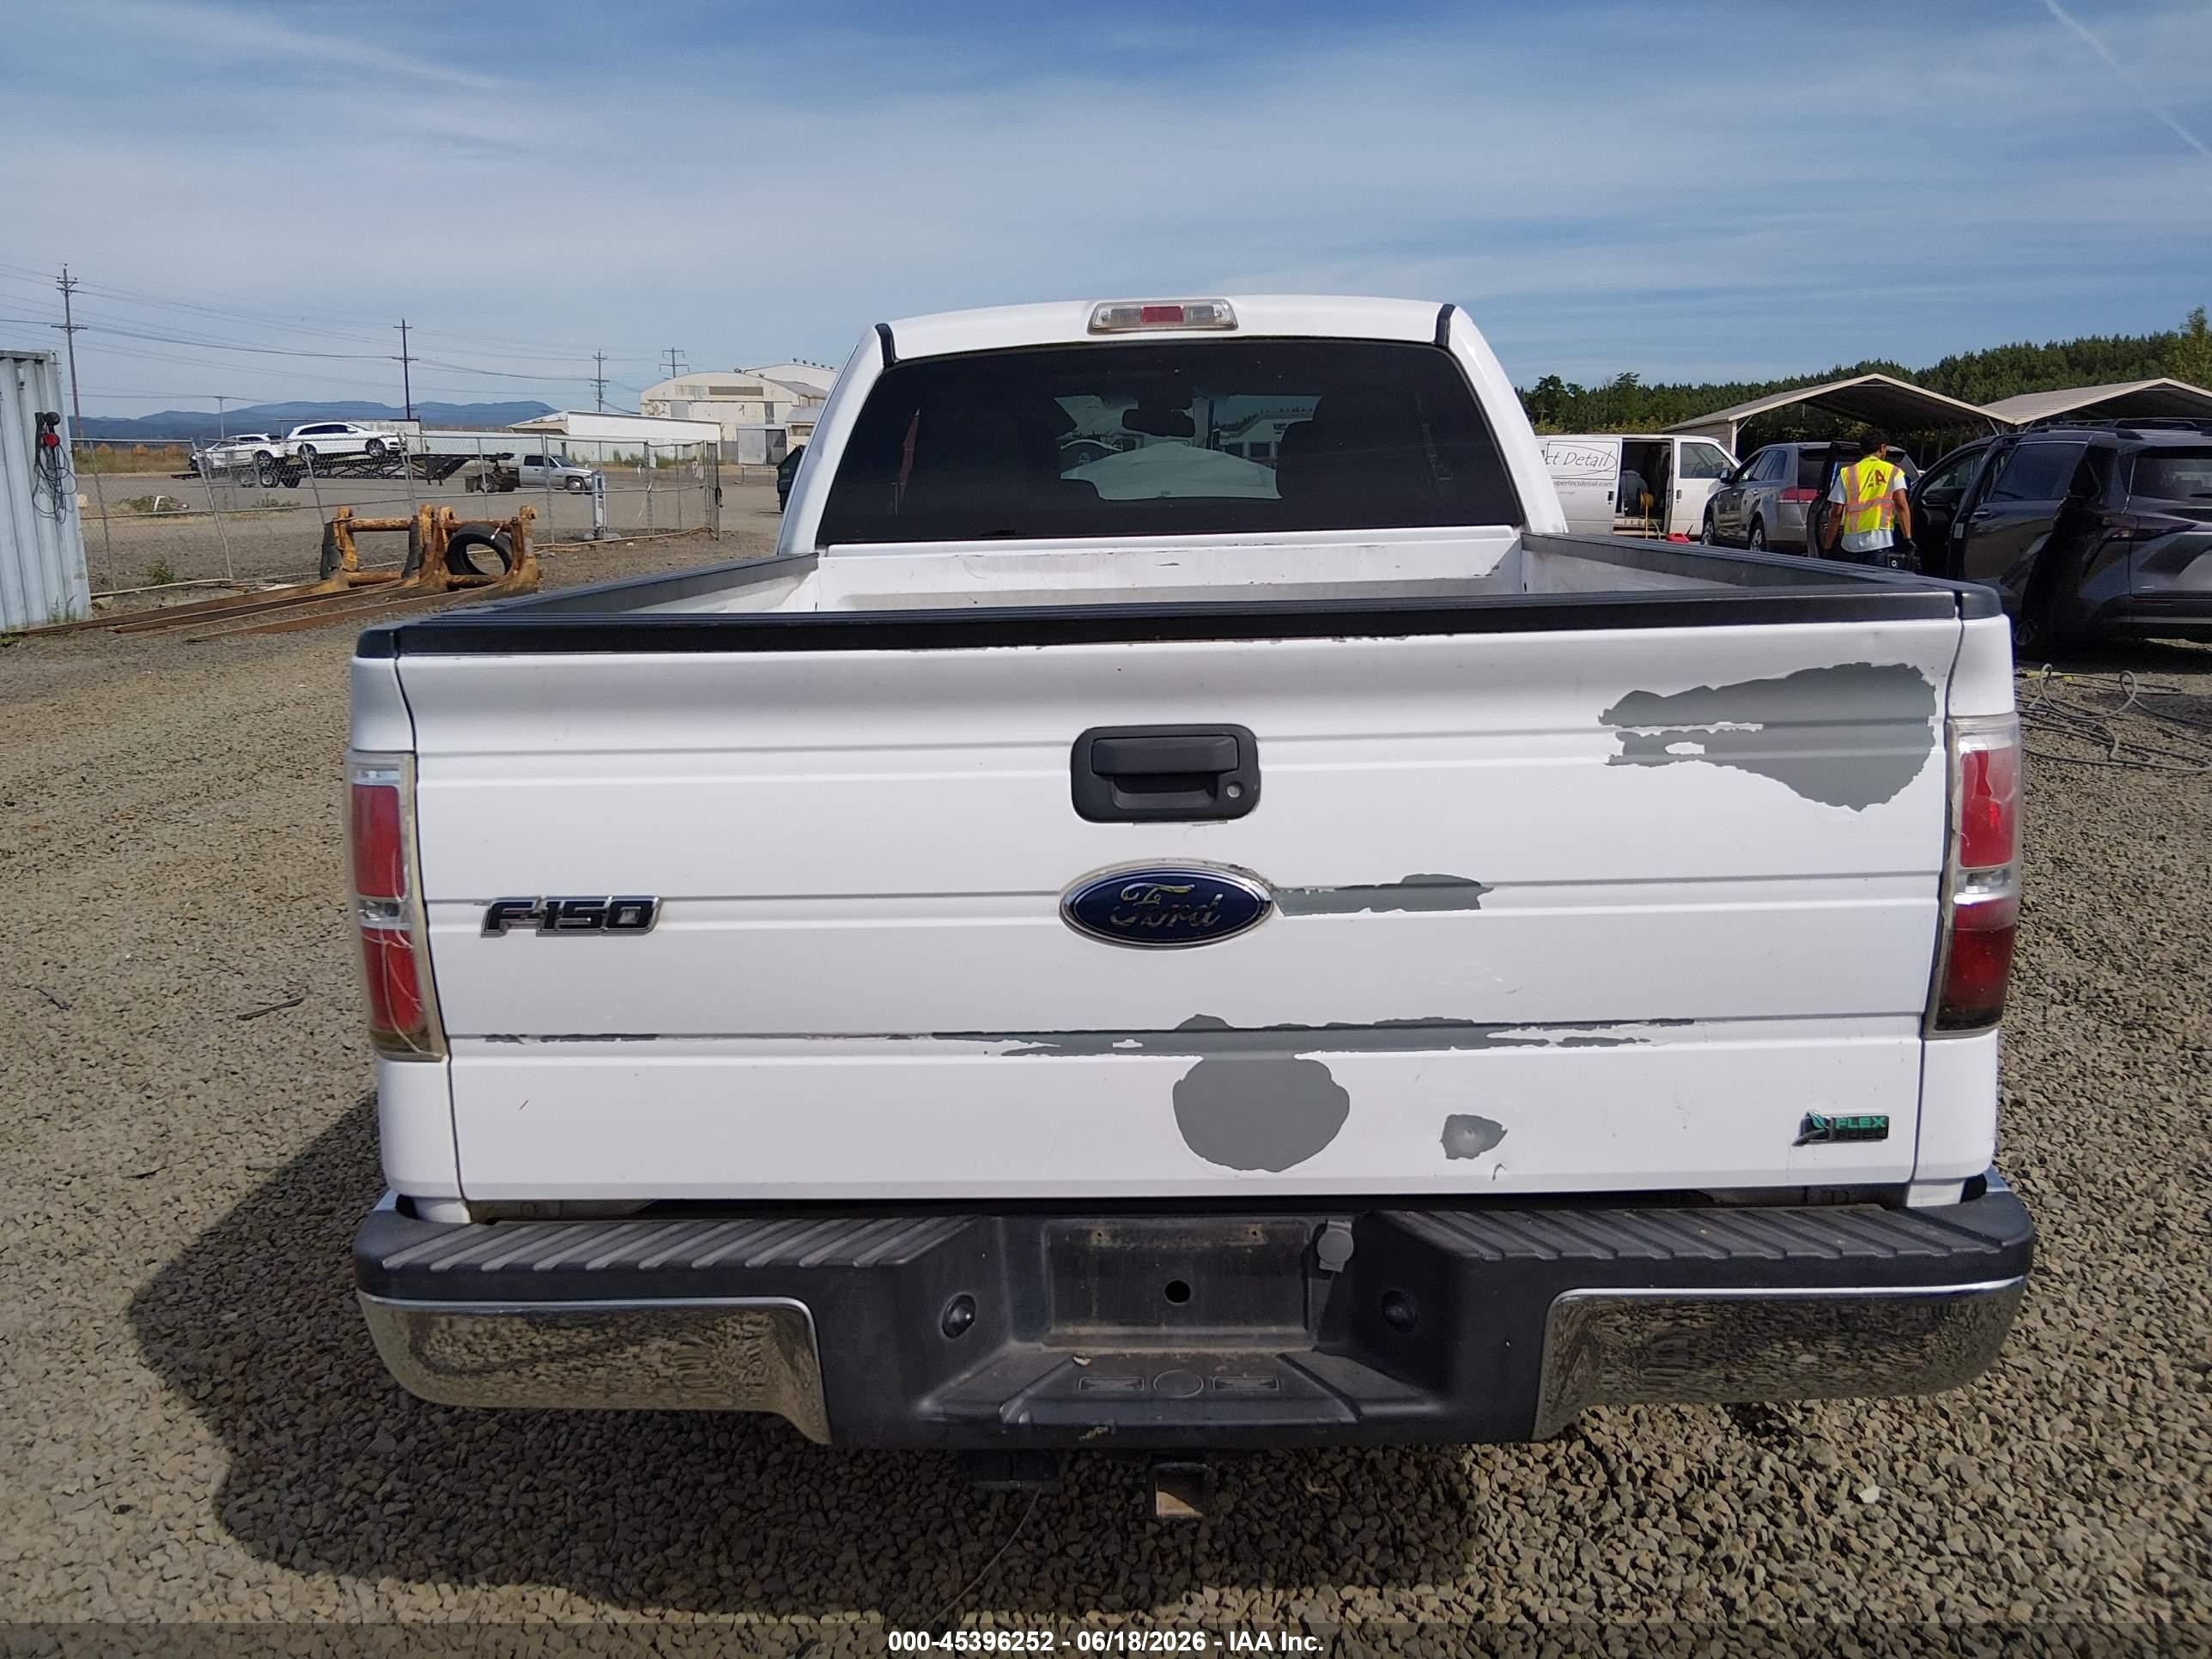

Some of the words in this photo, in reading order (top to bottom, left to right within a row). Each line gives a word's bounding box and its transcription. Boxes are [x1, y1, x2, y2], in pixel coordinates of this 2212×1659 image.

[1562, 450, 1612, 468] Detail
[1109, 881, 1224, 927] Ford
[1835, 1116, 1887, 1129] FLEX
